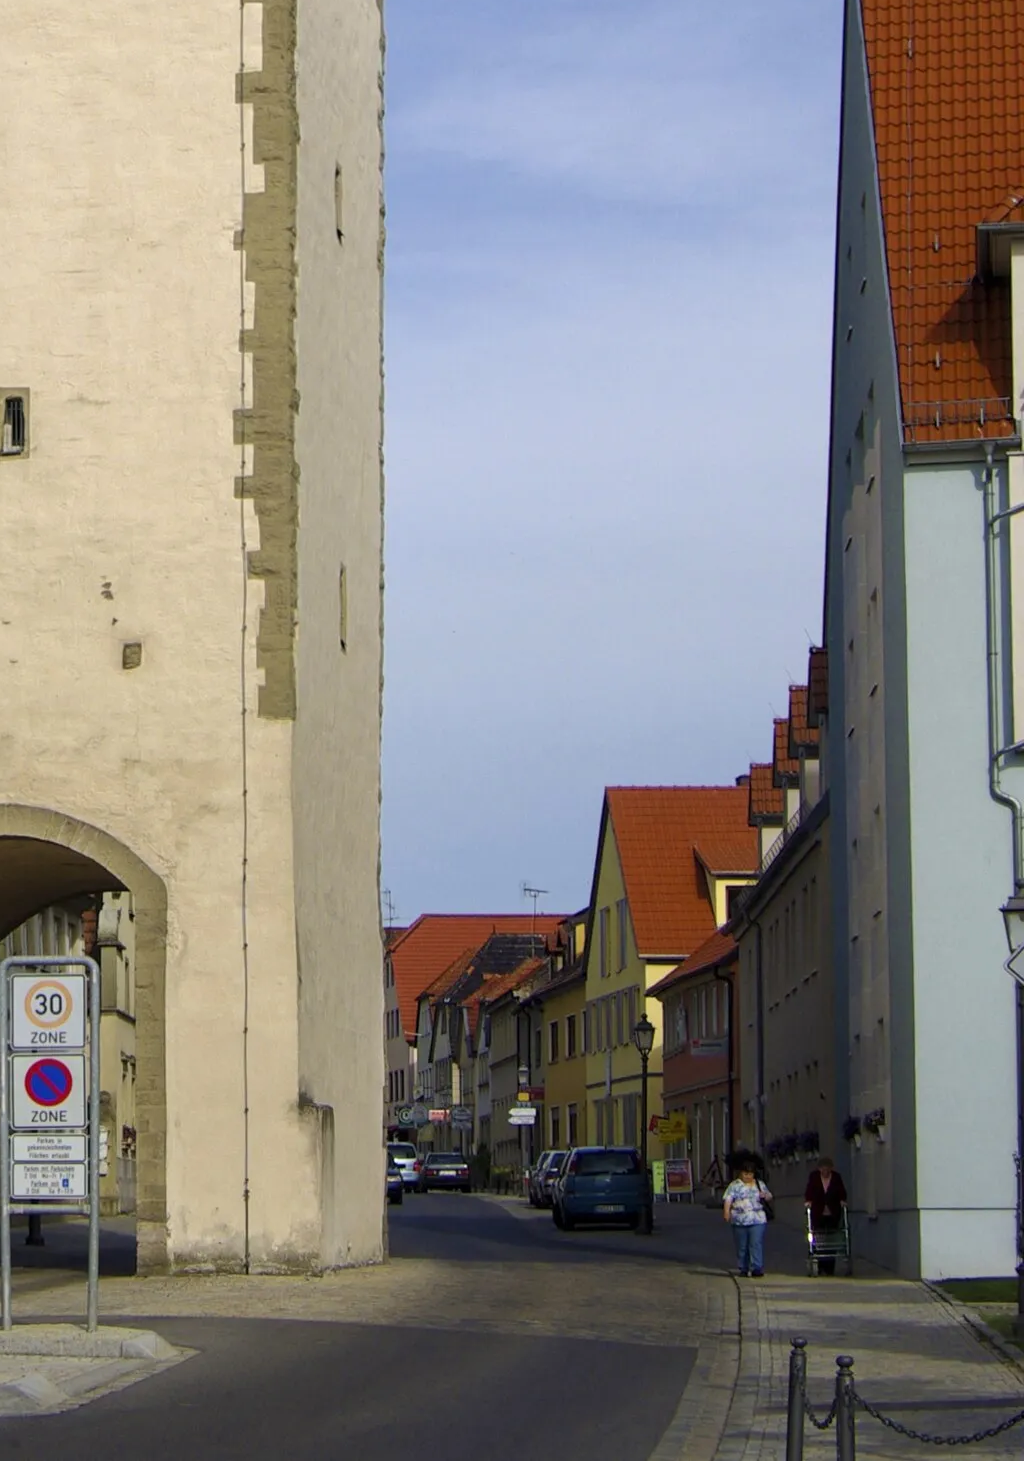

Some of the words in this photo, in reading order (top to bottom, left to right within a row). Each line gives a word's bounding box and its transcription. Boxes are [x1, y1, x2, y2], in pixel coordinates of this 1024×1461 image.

[34, 993, 63, 1016] 30
[30, 1031, 68, 1044] ZONE
[30, 1110, 68, 1123] ZONE
